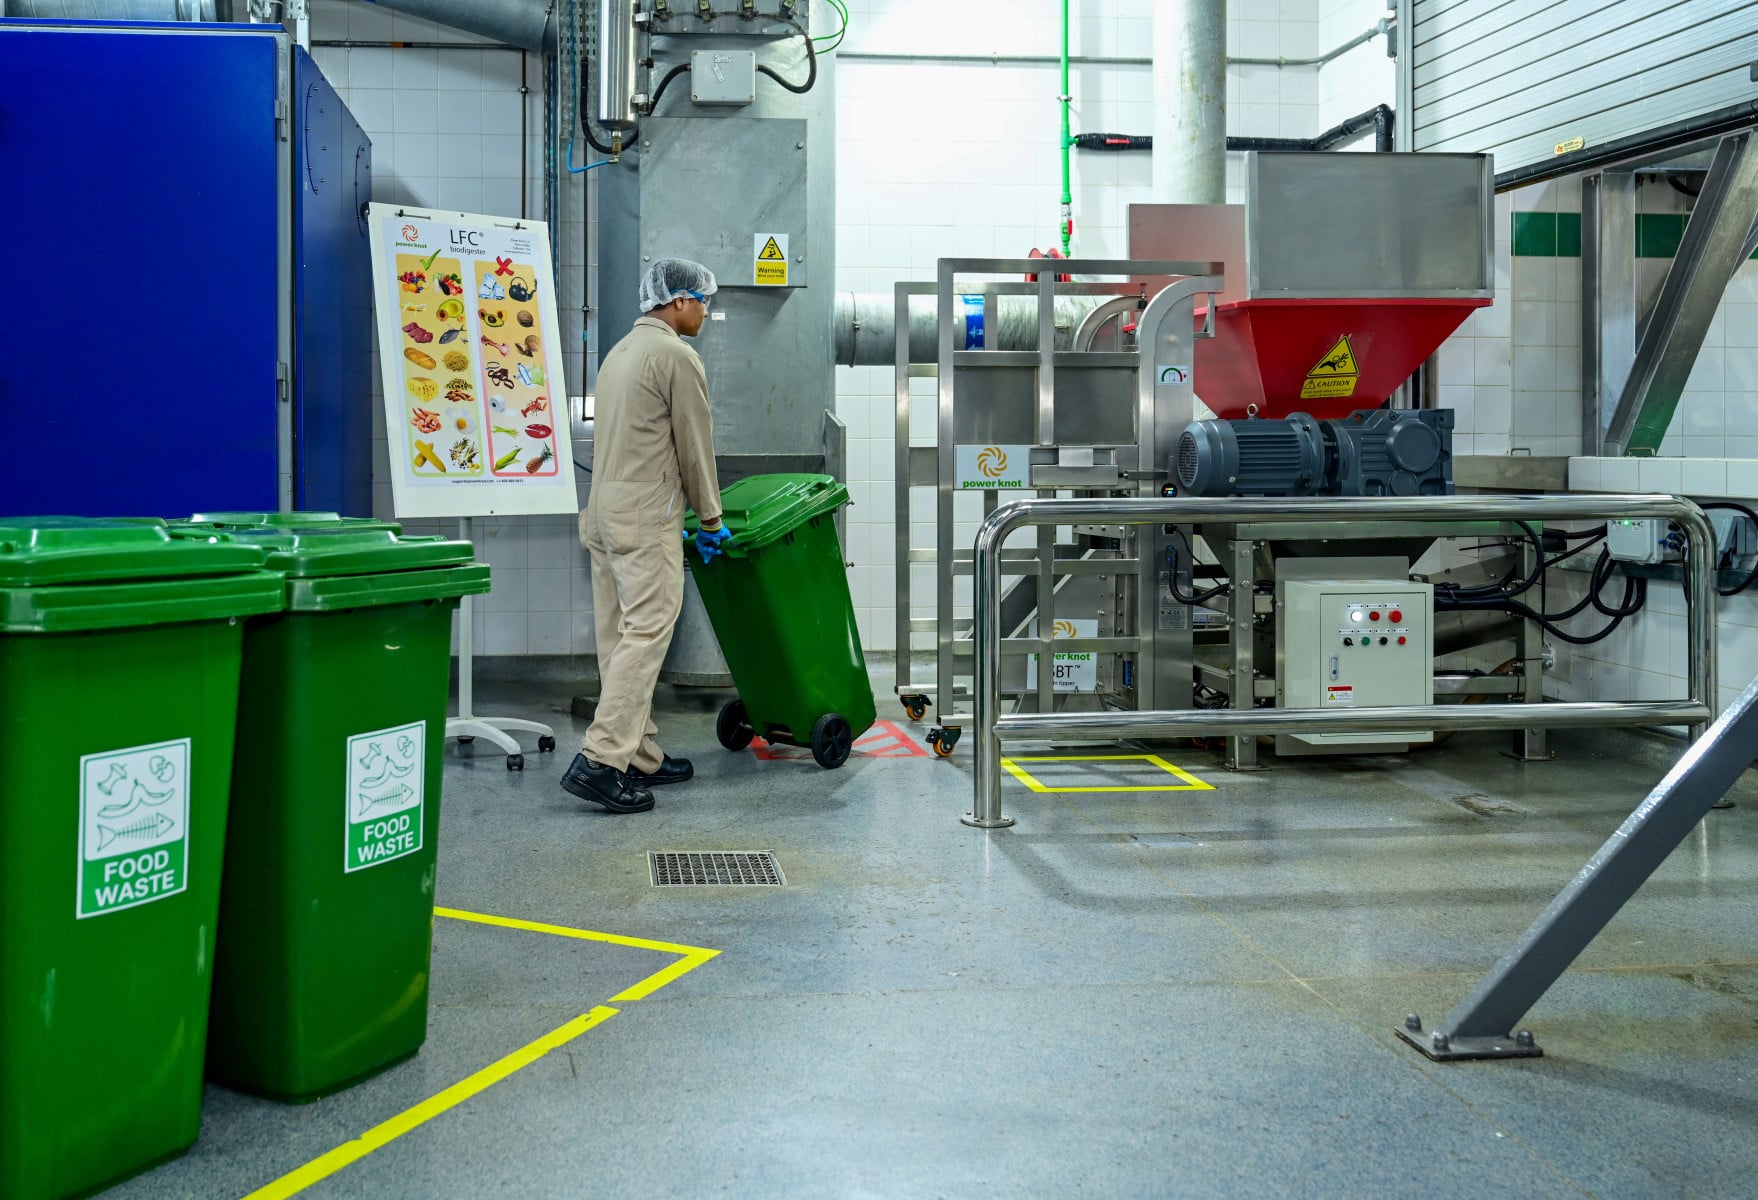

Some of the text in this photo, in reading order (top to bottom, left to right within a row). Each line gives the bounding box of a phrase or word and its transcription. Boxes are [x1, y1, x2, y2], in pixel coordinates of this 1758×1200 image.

[450, 245, 486, 255] biodigester
[963, 479, 1022, 488] power knot
[1067, 652, 1091, 661] knot
[364, 814, 410, 842] FOOD
[357, 831, 414, 863] WASTE
[104, 850, 169, 883] FOOD
[95, 869, 175, 907] WASTE
